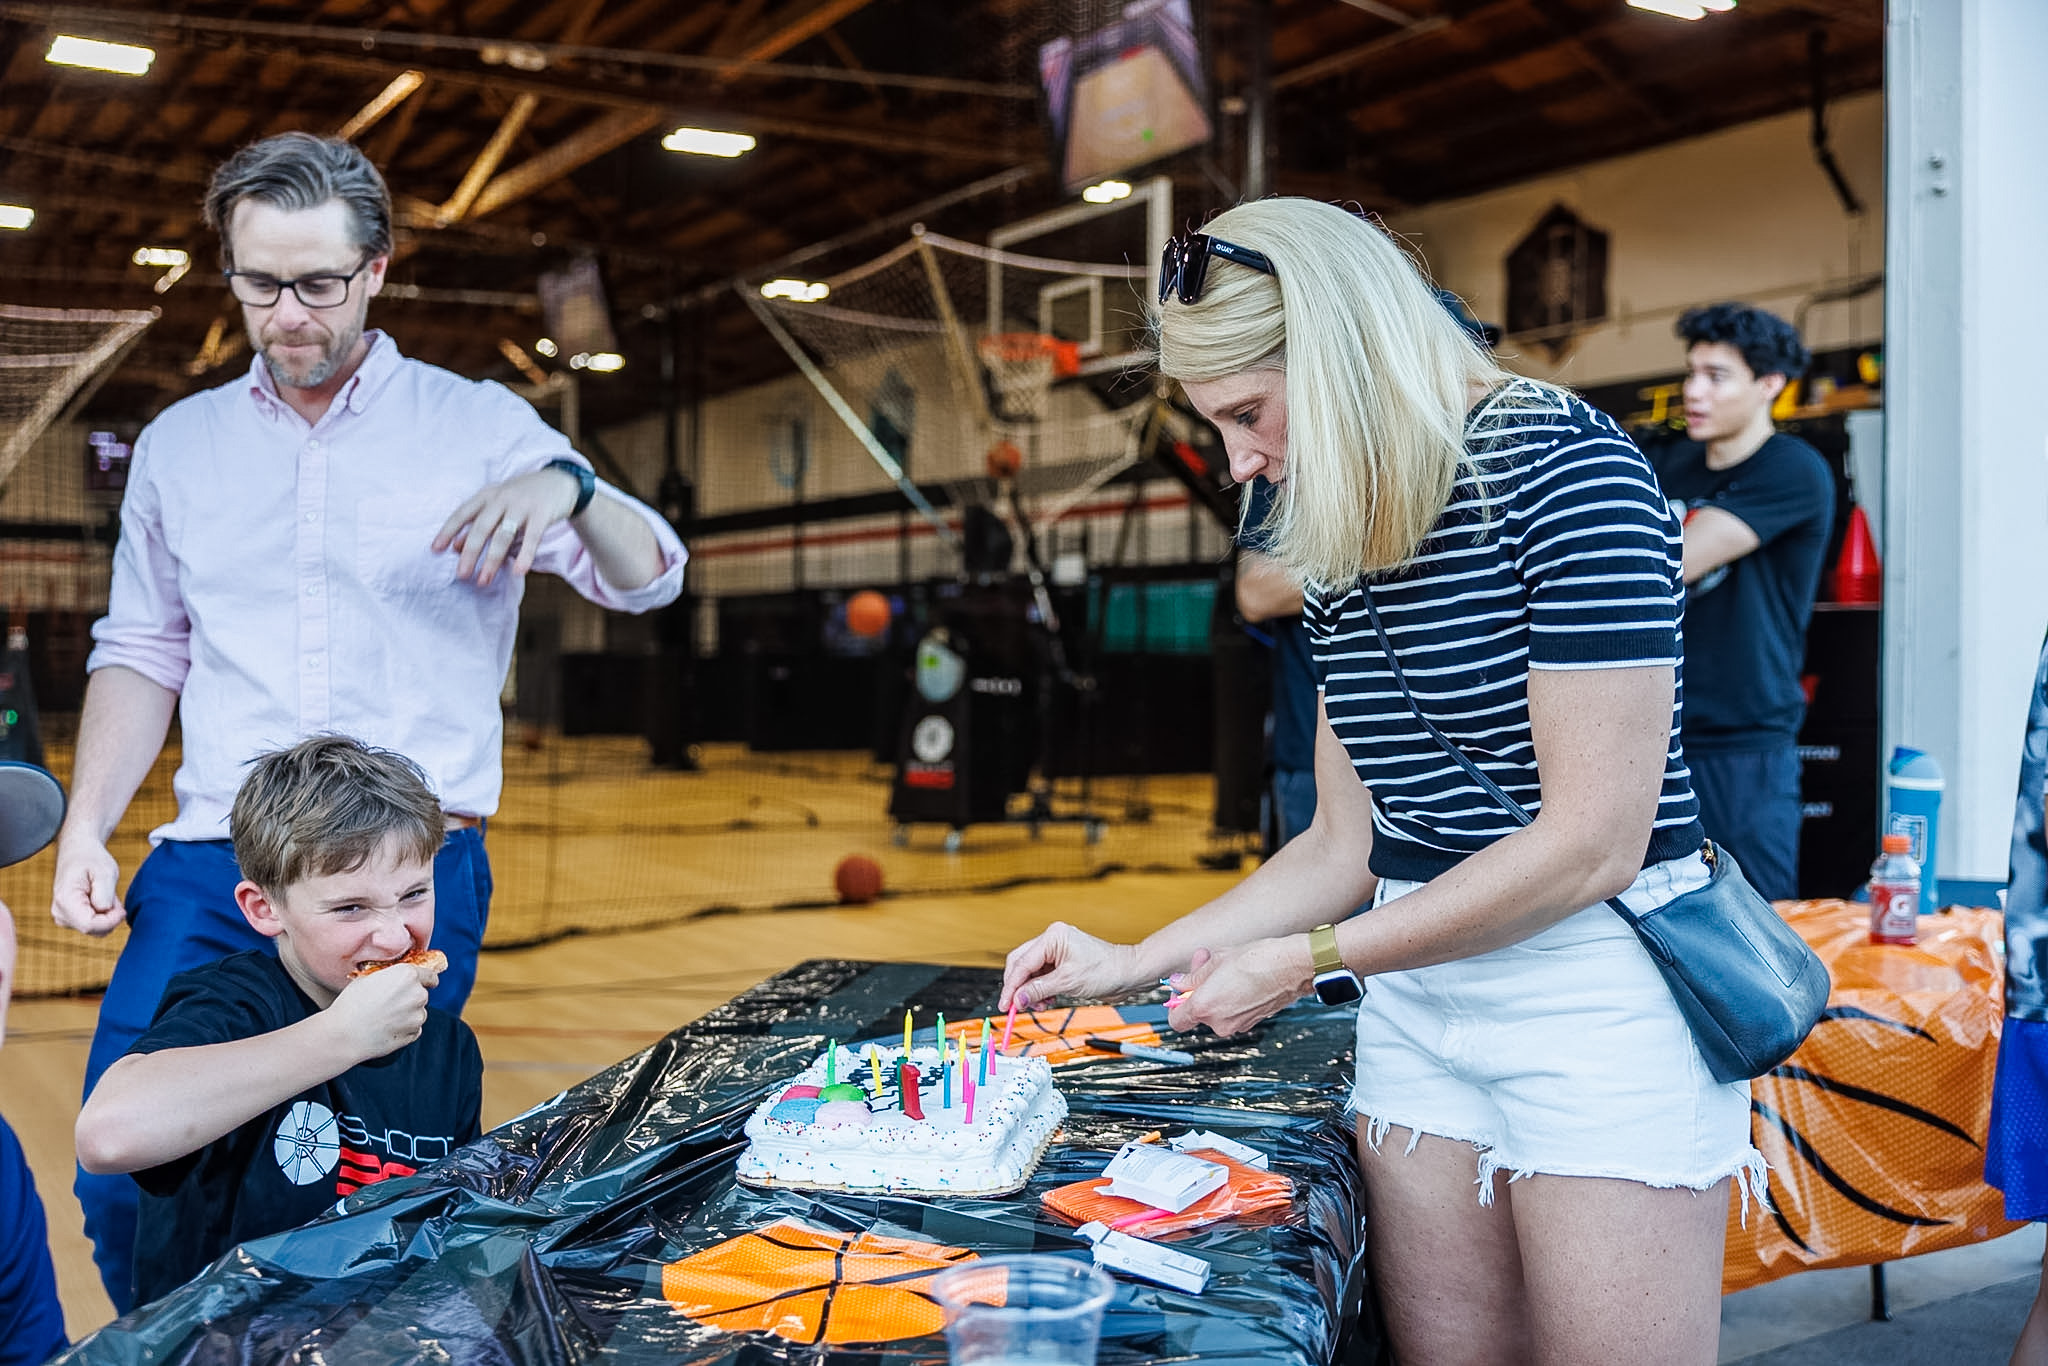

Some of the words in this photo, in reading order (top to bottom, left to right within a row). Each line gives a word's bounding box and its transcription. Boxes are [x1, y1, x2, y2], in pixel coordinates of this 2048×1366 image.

[1215, 243, 1234, 254] QUAY
[1889, 893, 1911, 917] G
[336, 1111, 454, 1163] SHOO
